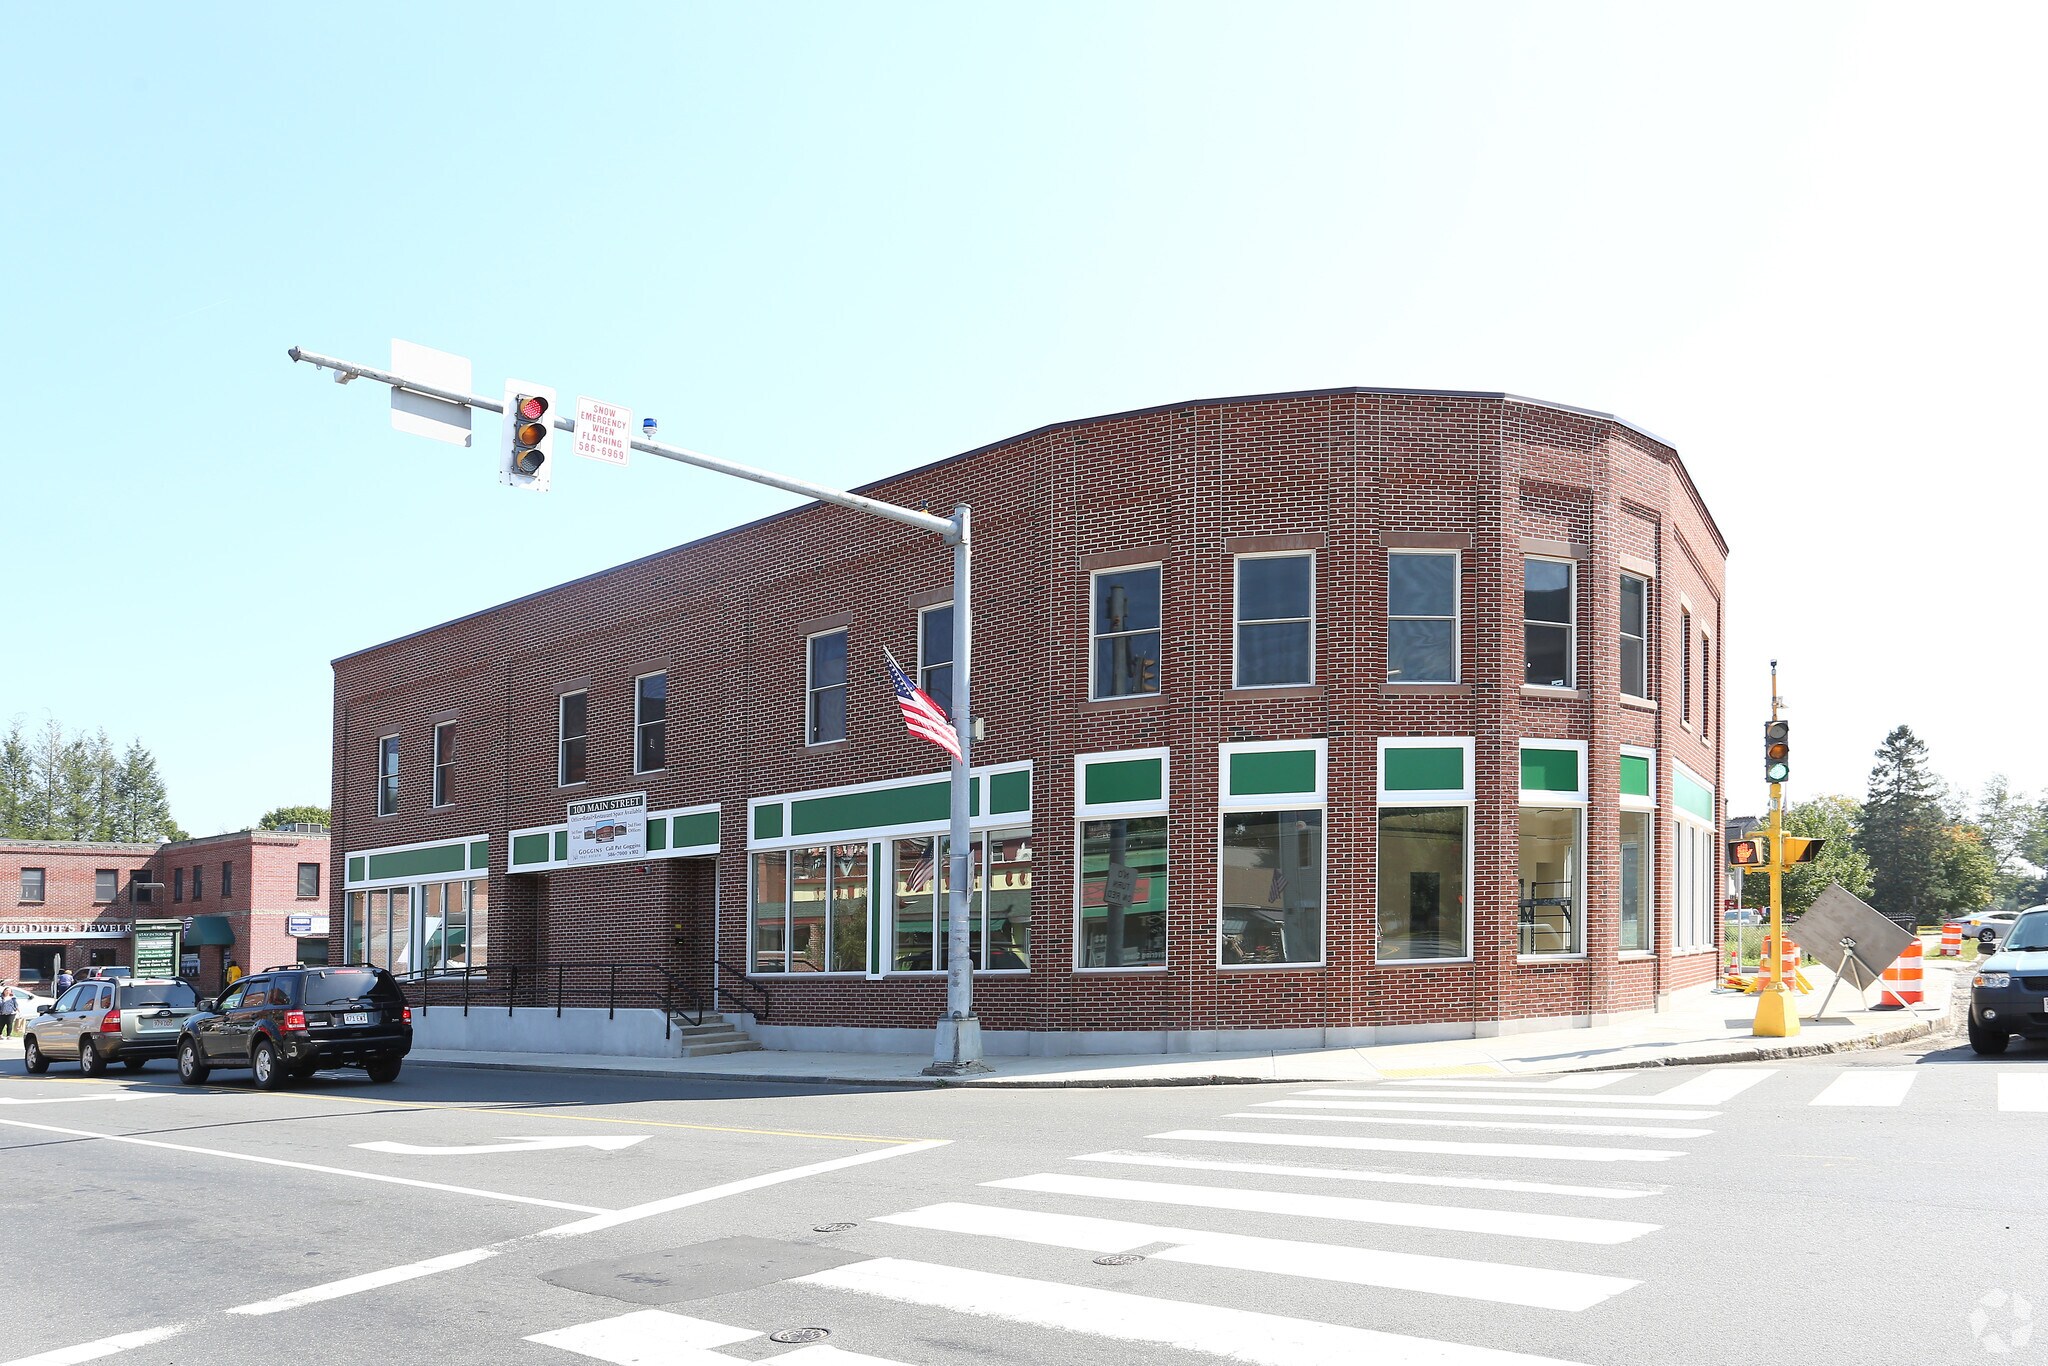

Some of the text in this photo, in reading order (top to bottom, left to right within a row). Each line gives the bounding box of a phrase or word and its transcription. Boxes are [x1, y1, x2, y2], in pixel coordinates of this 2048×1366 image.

[593, 404, 616, 418] SNOW
[580, 411, 627, 430] EMERGENCY
[592, 424, 615, 437] WHEN
[582, 431, 623, 449] FLASHING
[578, 441, 625, 460] 586-6969
[573, 797, 640, 815] 100 MAIN STREET
[623, 842, 641, 850] Goggins
[82, 922, 132, 933] JEWELR
